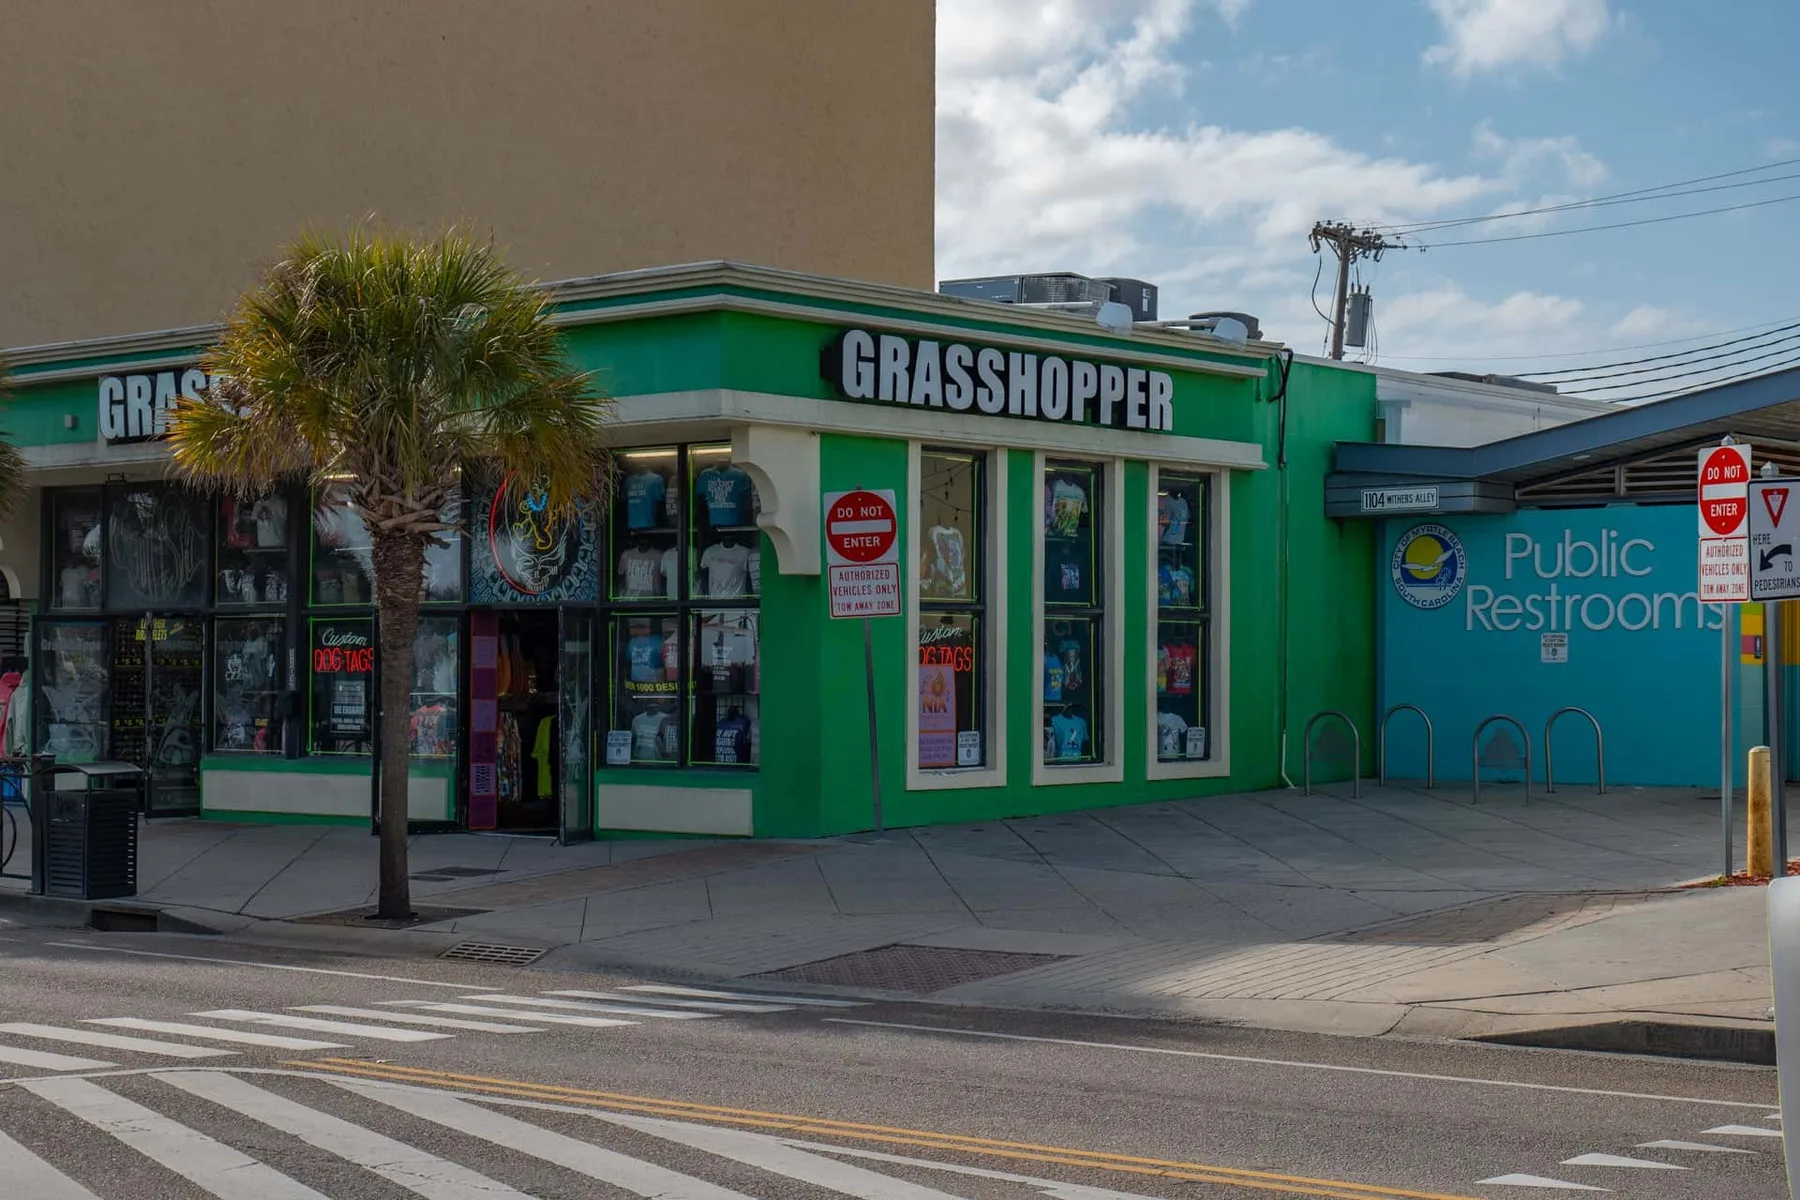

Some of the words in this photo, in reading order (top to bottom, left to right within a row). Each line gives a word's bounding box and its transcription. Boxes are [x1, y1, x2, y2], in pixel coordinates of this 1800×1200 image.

[841, 329, 1174, 432] GRASSHOPPER
[1707, 467, 1720, 481] DO
[1724, 464, 1741, 479] NOT
[1364, 491, 1385, 509] 1104
[1386, 493, 1413, 504] WITHERS
[1415, 491, 1436, 503] ALLEY
[837, 507, 854, 519] DO
[860, 505, 883, 517] NOT
[1710, 502, 1738, 517] ENTER
[843, 536, 881, 549] ENTER
[1752, 532, 1771, 546] HERE
[1393, 547, 1403, 570] CITY
[1400, 532, 1412, 546] OF
[1411, 525, 1449, 538] MYRTLE
[1449, 535, 1465, 570] BEACH
[1504, 528, 1655, 579] Public
[1705, 544, 1744, 558] AUTHORIZED
[1701, 562, 1730, 577] VEHICLES
[1731, 561, 1748, 575] ONLY
[1784, 560, 1793, 573] TO
[839, 569, 890, 582] AUTHORIZED
[833, 585, 872, 597] VEHICLES
[876, 584, 896, 595] ONLY
[1395, 577, 1421, 604] SOUTH
[1421, 576, 1463, 607] CAROLINA
[1703, 583, 1714, 595] TOW
[1716, 583, 1730, 594] AWAY
[1731, 582, 1745, 594] ZONE
[1754, 576, 1800, 592] PEDESTRIANS
[837, 602, 852, 612] TOW
[854, 601, 873, 611] AWAY
[877, 600, 895, 610] ZONE
[1466, 582, 1724, 631] Restrooms
[321, 627, 368, 646] Custom
[314, 647, 343, 673] DOG
[344, 648, 374, 673] TAGS
[939, 646, 973, 672] TAGS
